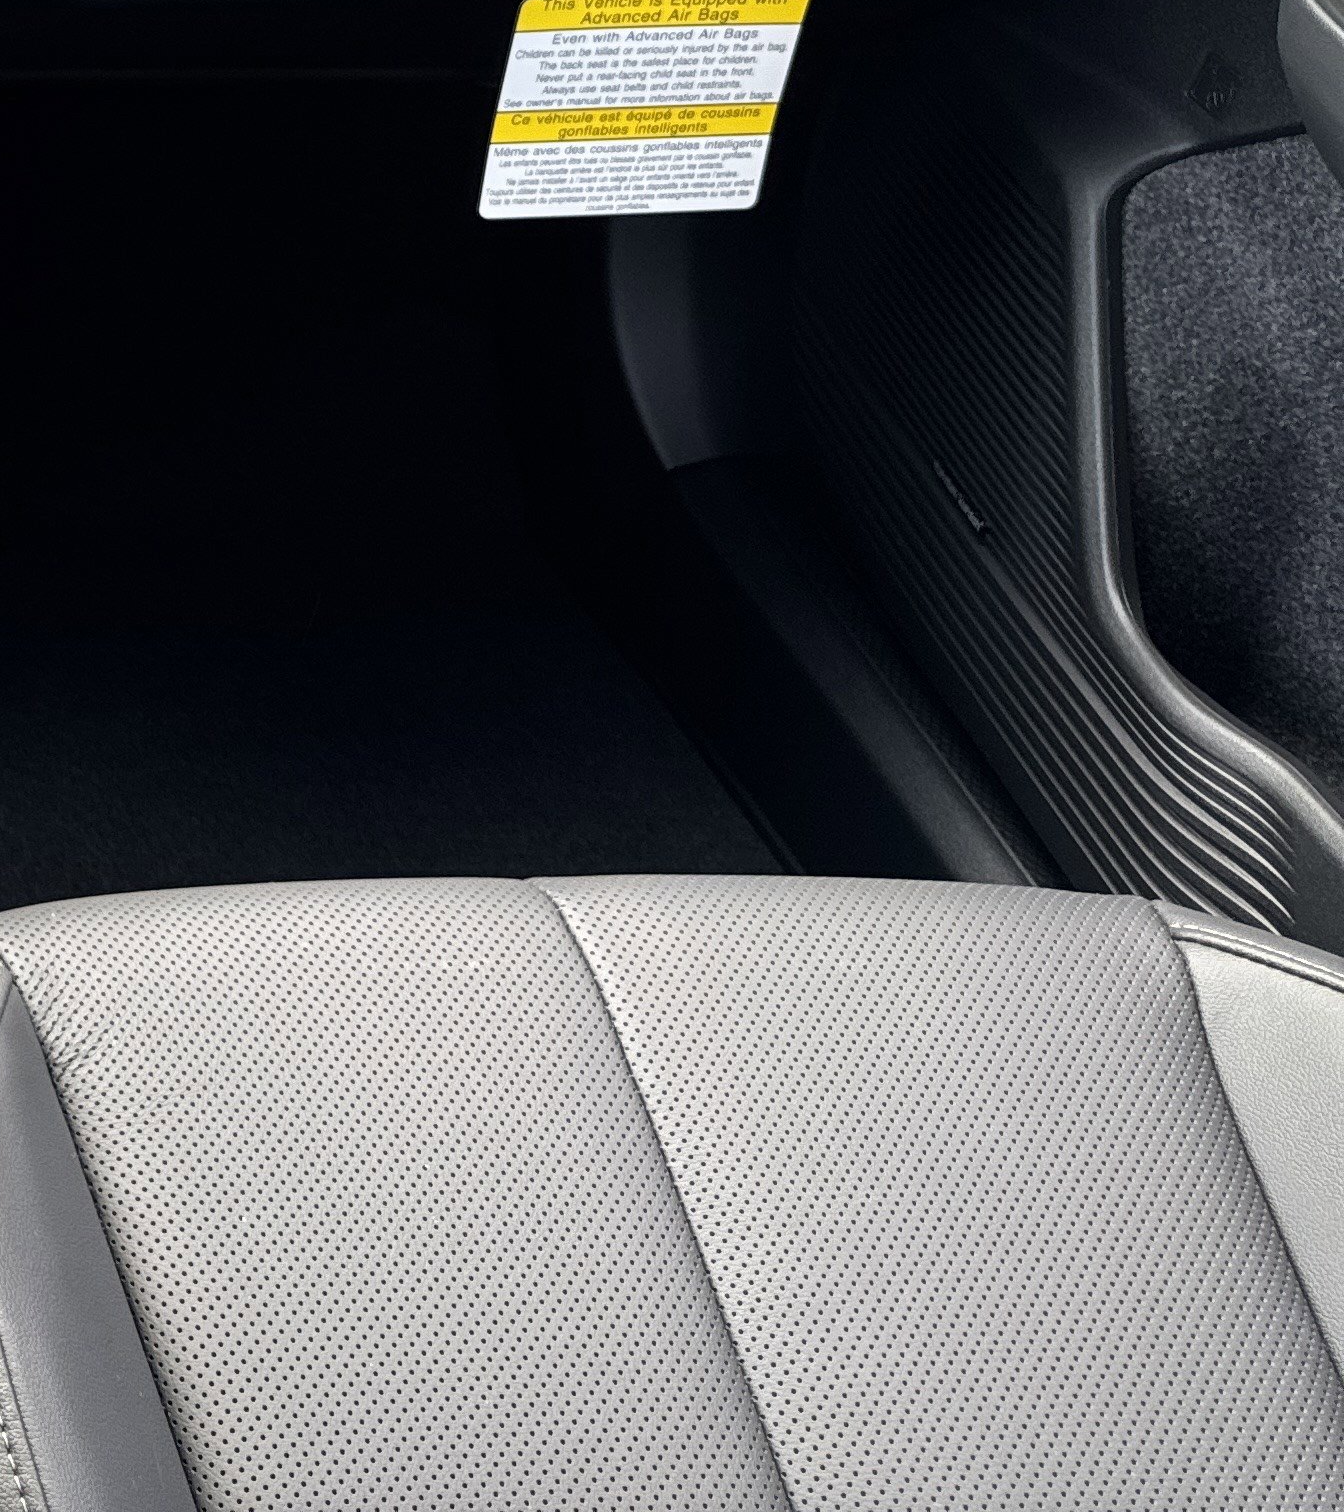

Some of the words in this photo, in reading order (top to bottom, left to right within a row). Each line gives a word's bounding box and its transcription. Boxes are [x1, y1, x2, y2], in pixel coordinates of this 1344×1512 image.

[580, 9, 662, 25] Advanced
[667, 8, 691, 22] Air
[698, 7, 739, 24] Bags
[552, 33, 586, 45] Even
[593, 31, 620, 43] with
[625, 29, 694, 42] Advanced
[698, 28, 719, 39] Air
[724, 28, 759, 41] Bags
[515, 49, 554, 60] Children
[682, 43, 714, 55] injured
[717, 43, 729, 54] by
[511, 114, 531, 126] Ce
[536, 112, 594, 125] véhicule
[599, 111, 622, 122] est
[626, 108, 673, 124] équipé
[678, 109, 695, 119] de
[700, 106, 761, 119] coussins
[558, 124, 629, 140] gonflables
[634, 121, 708, 136] intelligents
[533, 146, 561, 156] avec
[564, 145, 586, 155] des
[590, 143, 639, 154] coussins
